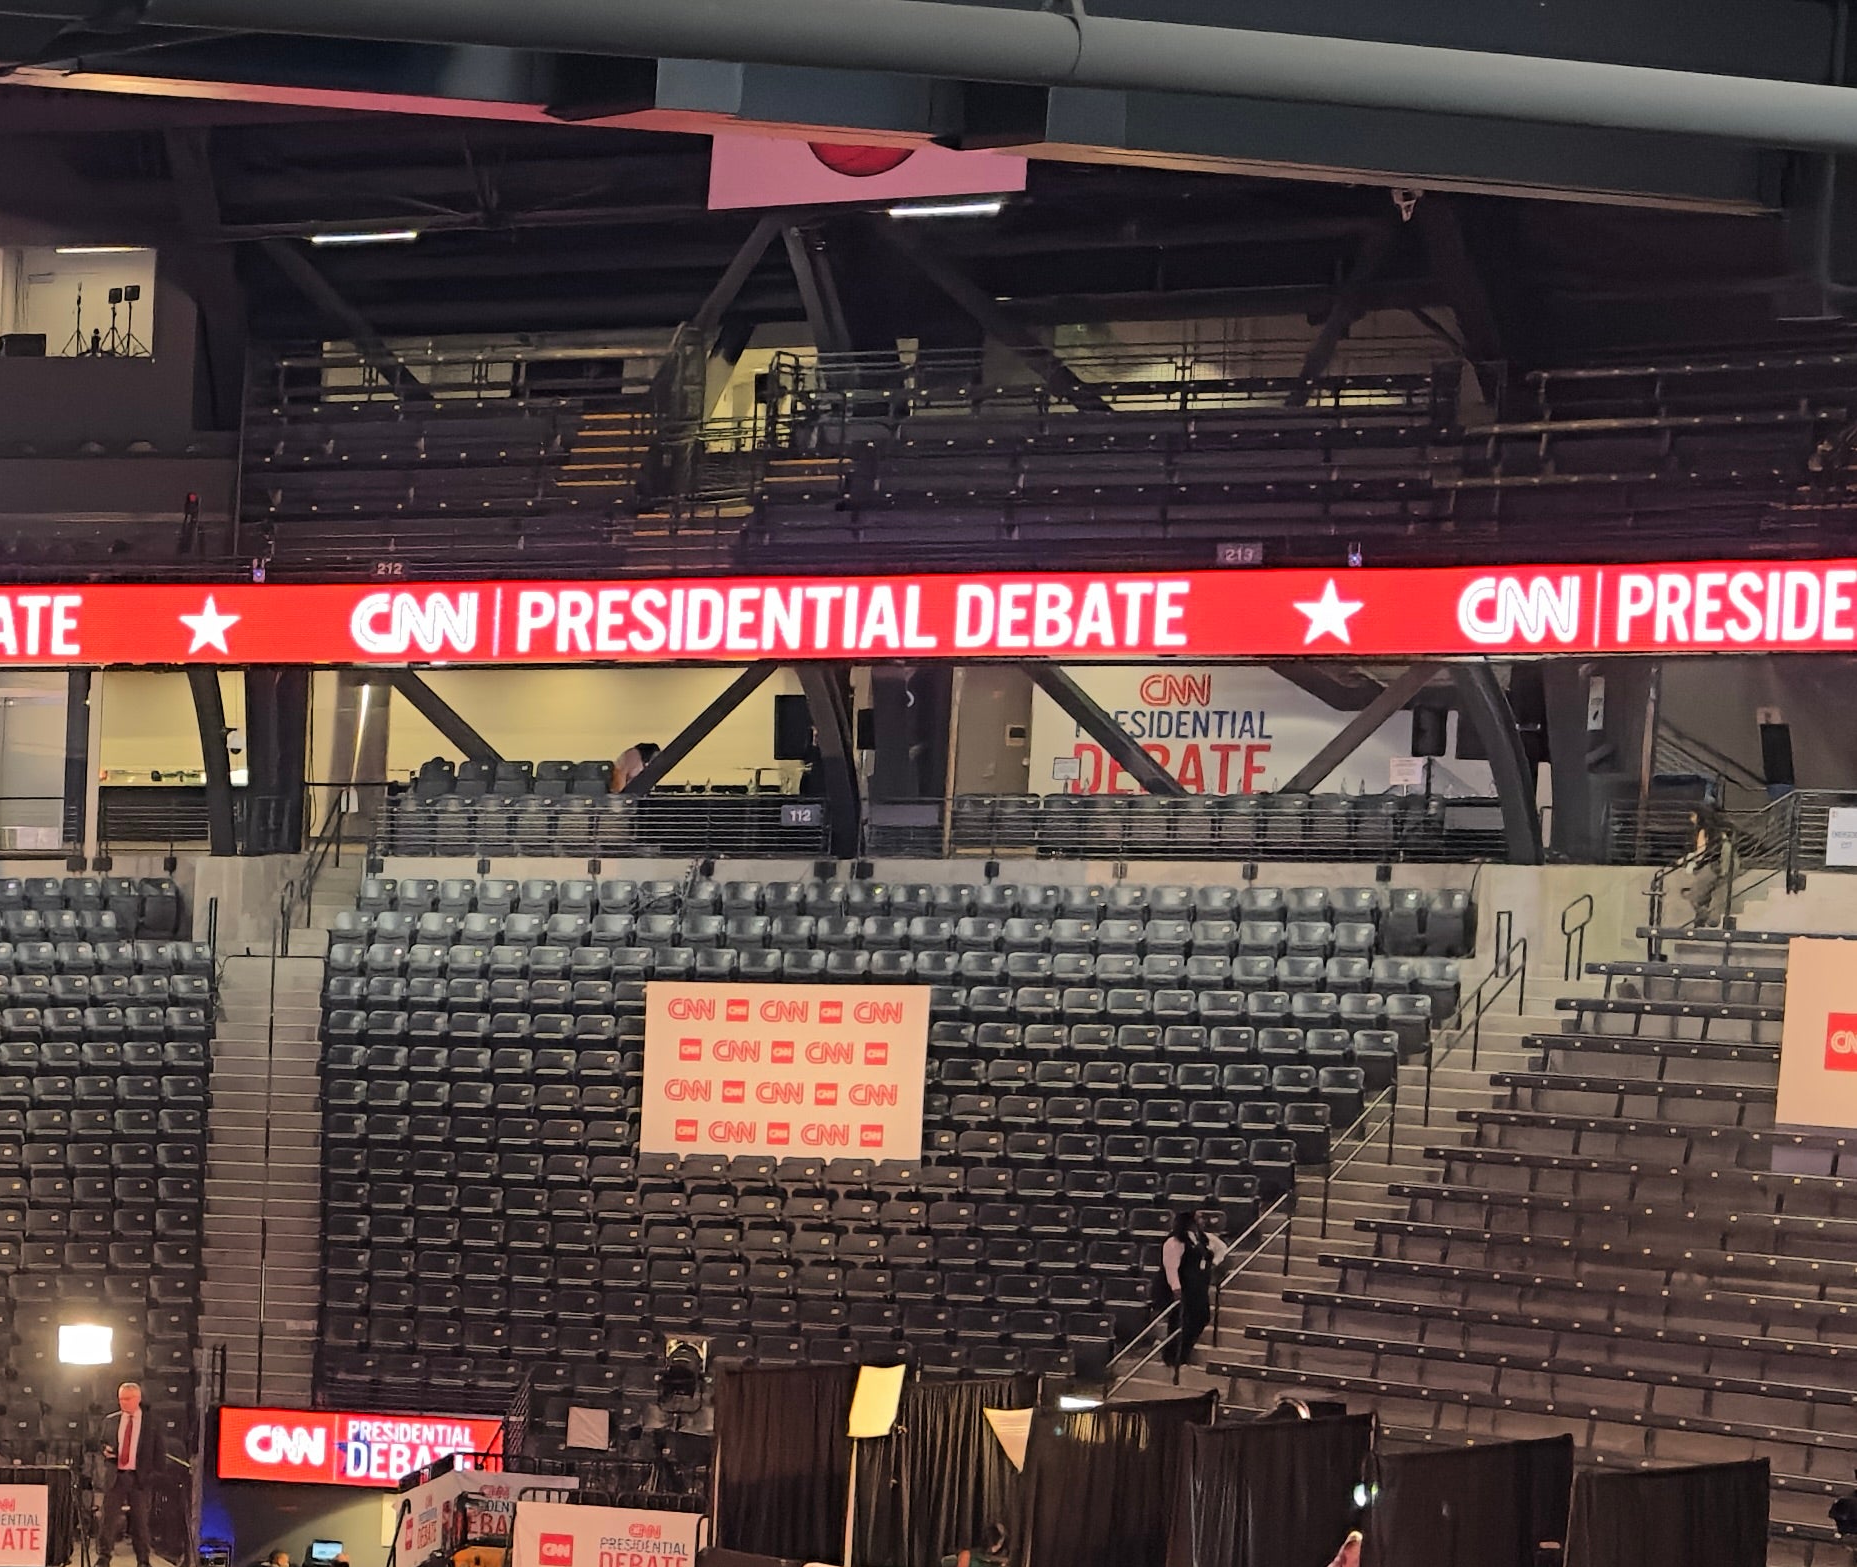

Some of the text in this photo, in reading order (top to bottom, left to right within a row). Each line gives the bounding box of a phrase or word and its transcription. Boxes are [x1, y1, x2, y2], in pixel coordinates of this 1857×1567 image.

[1226, 548, 1253, 561] 213
[377, 562, 402, 574] 212
[350, 580, 1190, 655] CNN PRESIDENTIAL DEBATE
[1458, 570, 1856, 644] CNN PRESIDE
[1140, 674, 1211, 707] CNN
[790, 810, 811, 821] 112
[668, 998, 903, 1024] CNN CNN CNN
[712, 1040, 854, 1064] CNN CNN
[664, 1079, 897, 1106] CNN CNN CNN
[708, 1121, 850, 1146] CNN CNN
[245, 1424, 326, 1466] CNN
[347, 1420, 474, 1446] PRESIDENTIAL
[629, 1523, 661, 1539] CNN
[600, 1537, 689, 1556] PRESIDENTIAL
